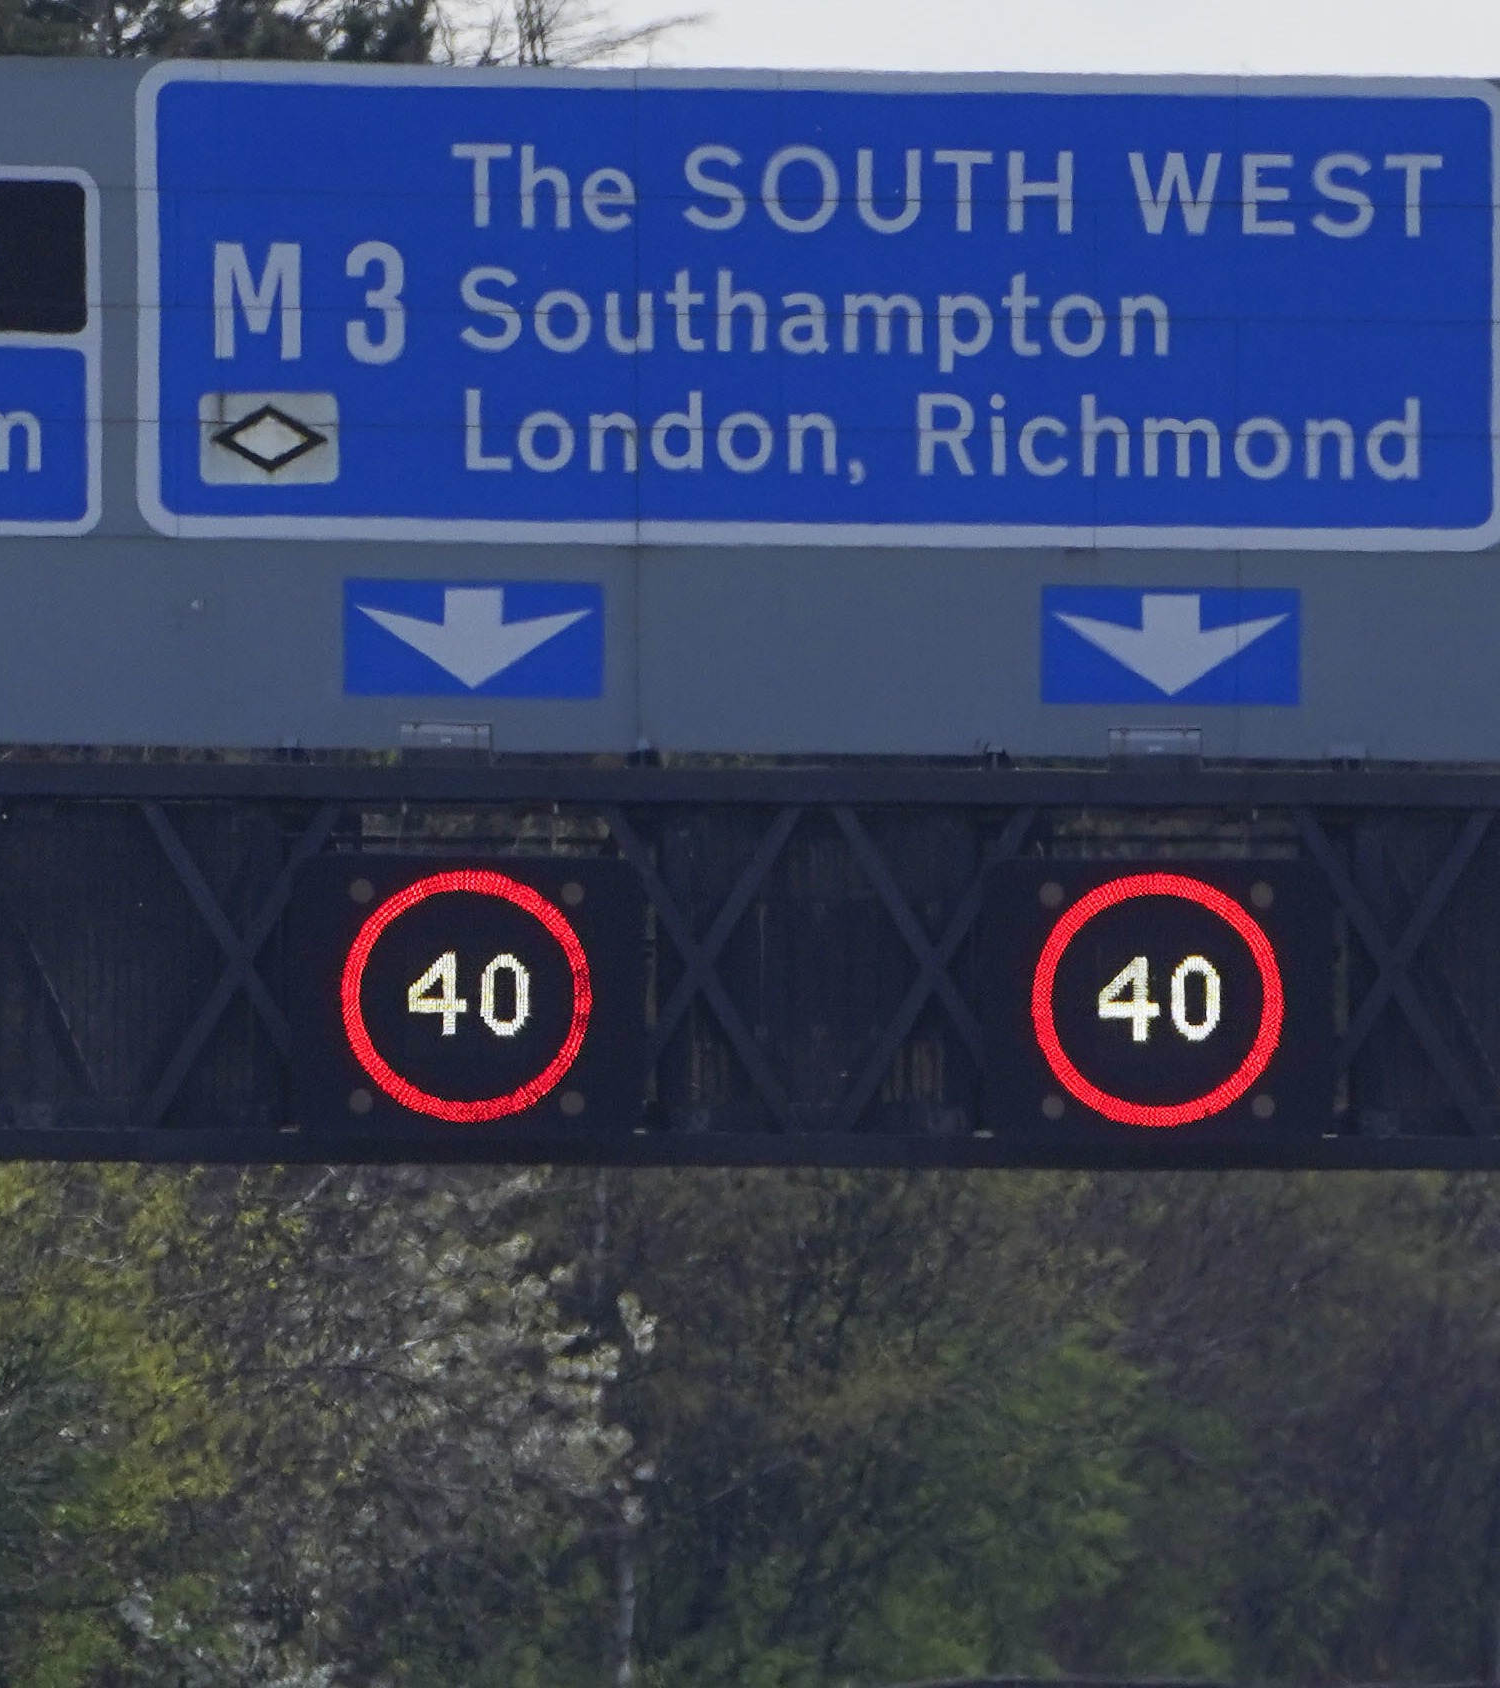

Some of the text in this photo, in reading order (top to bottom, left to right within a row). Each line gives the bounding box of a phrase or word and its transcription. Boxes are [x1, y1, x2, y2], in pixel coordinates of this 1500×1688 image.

[452, 143, 1442, 237] The SOUTH WEST
[460, 266, 1169, 360] Southampton
[466, 389, 1420, 484] London, Richmond
[409, 952, 529, 1036] 40
[1098, 957, 1220, 1041] 40
